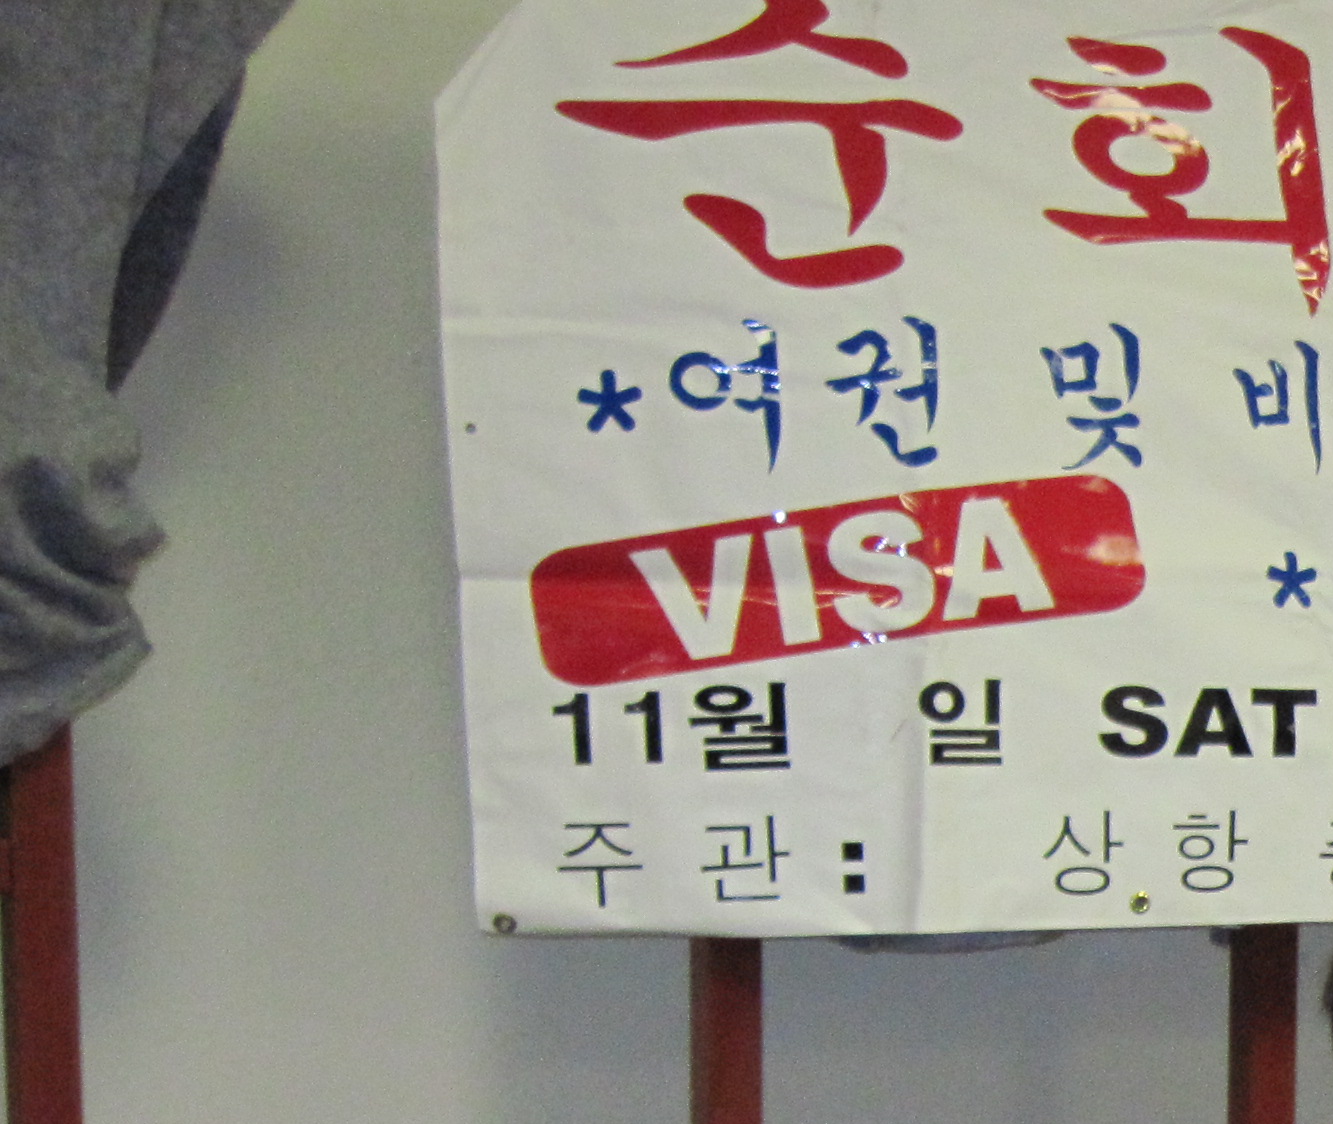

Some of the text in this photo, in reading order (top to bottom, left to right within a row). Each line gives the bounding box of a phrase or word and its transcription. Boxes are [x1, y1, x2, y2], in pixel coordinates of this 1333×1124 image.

[555, 0, 1330, 316] 순회
[1040, 323, 1143, 470] 및
[630, 498, 1053, 661] VISA
[551, 682, 790, 770] 11월
[918, 679, 1002, 765] 일
[1099, 685, 1317, 757] SAT
